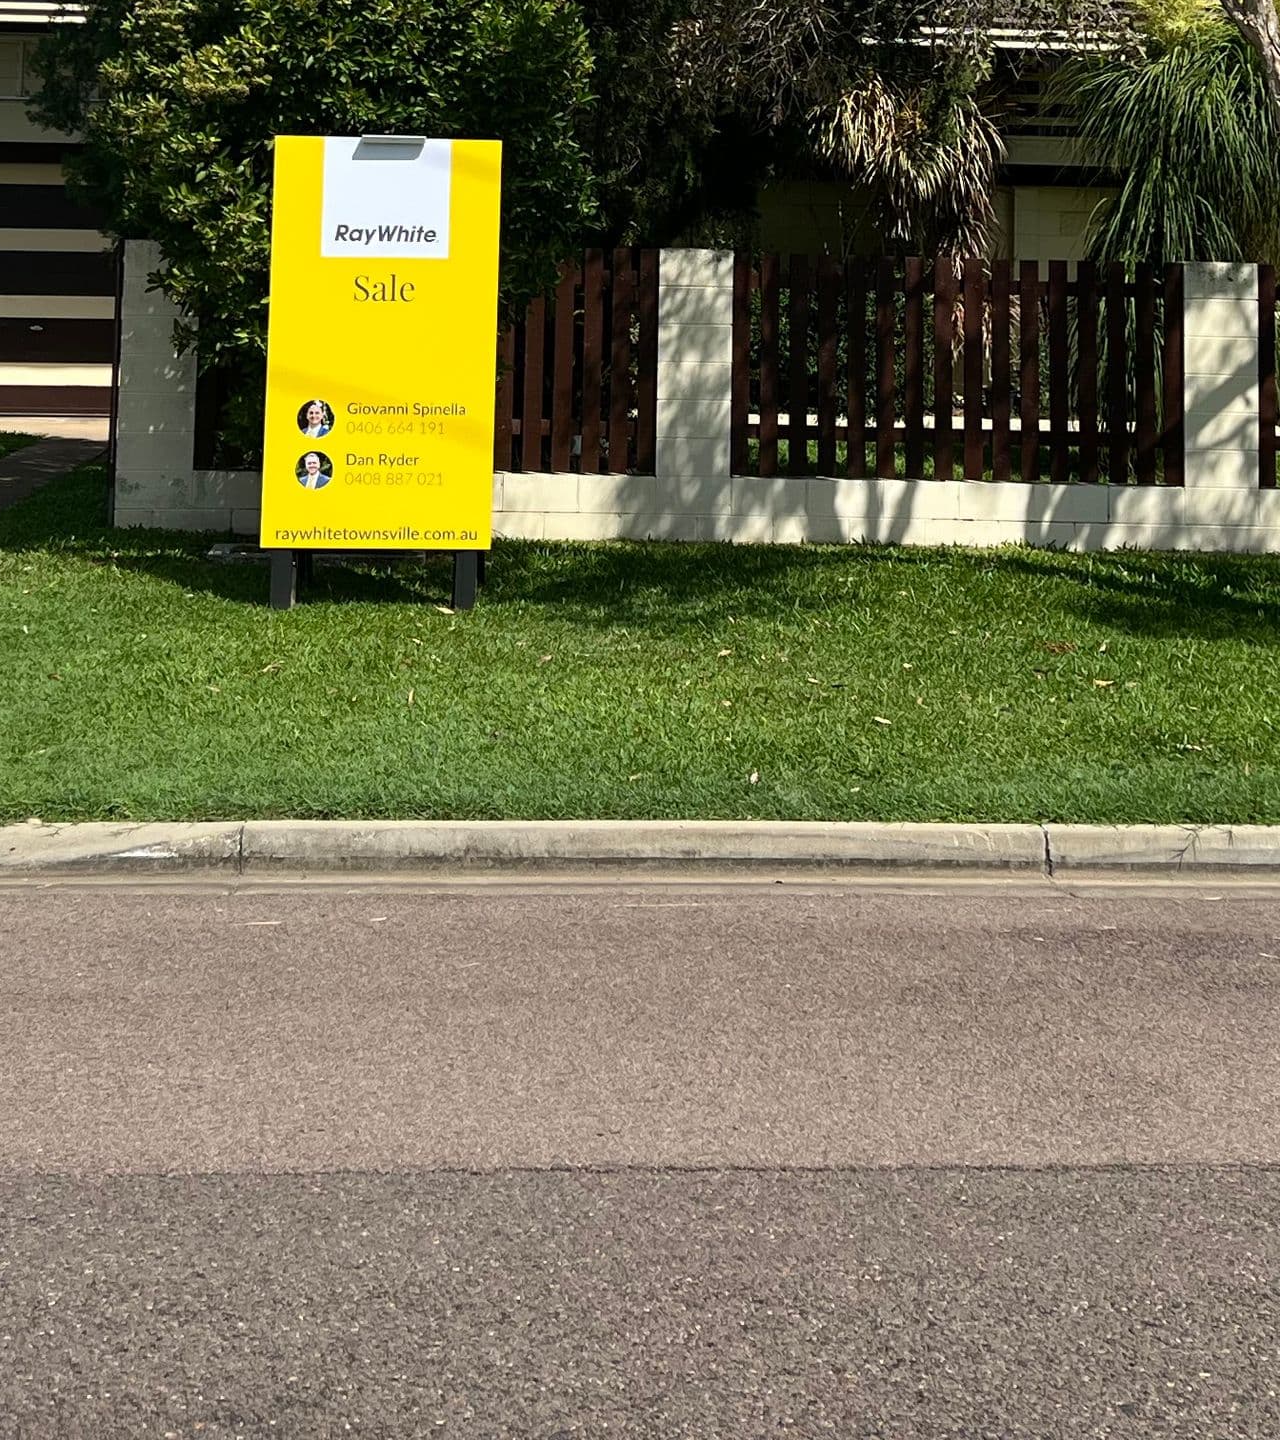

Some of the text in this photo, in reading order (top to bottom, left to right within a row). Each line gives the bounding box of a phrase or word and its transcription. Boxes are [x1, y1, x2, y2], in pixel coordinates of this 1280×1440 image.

[353, 274, 415, 302] Sale
[347, 401, 466, 417] Giovanni Spinella
[346, 421, 445, 435] 0406 664 191
[346, 453, 420, 468] Dan Ryder
[344, 472, 381, 486] 0408
[417, 473, 443, 486] 021
[275, 526, 478, 542] raywhitetownsville.com.au
